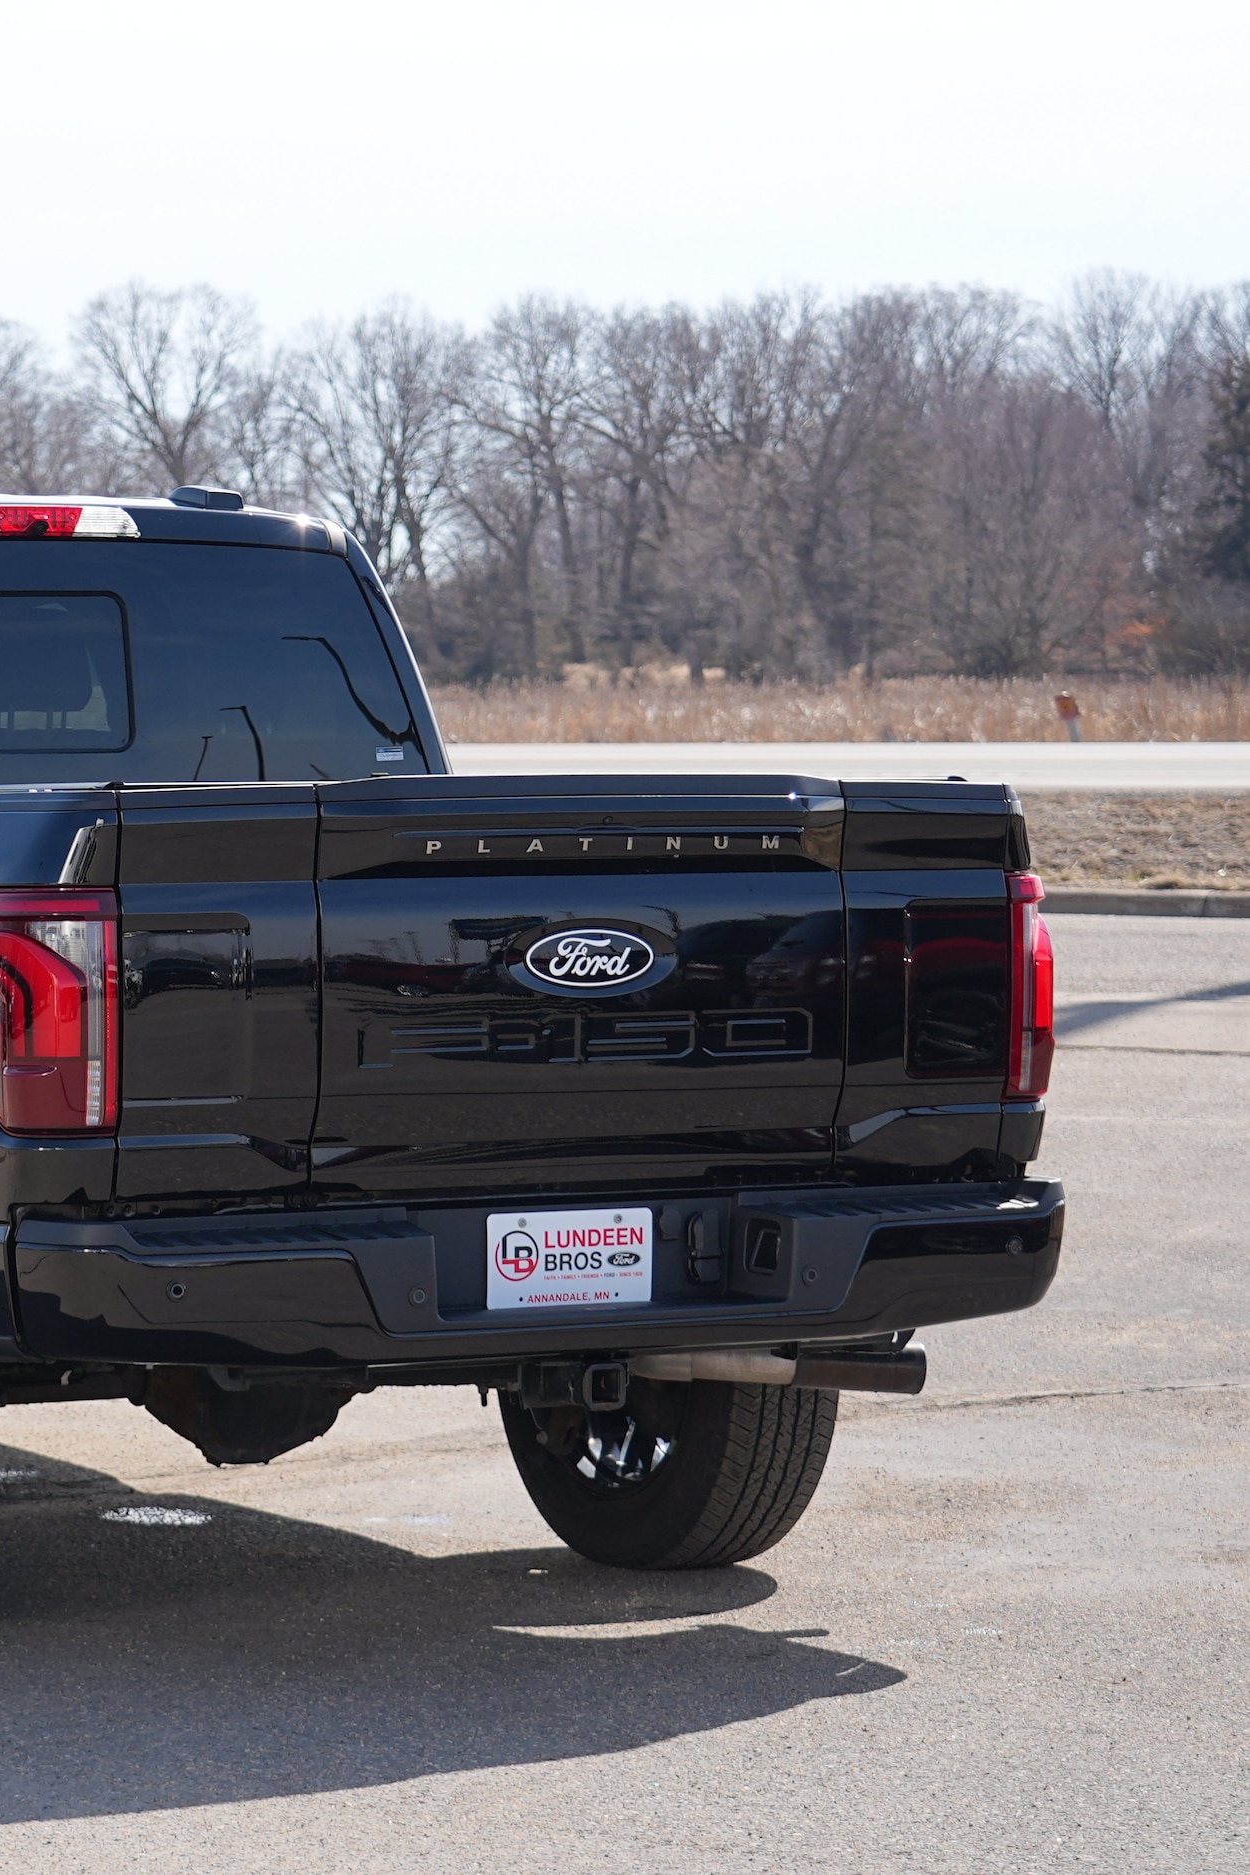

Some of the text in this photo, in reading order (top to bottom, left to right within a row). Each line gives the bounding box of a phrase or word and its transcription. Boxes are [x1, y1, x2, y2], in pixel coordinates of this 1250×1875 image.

[425, 834, 781, 856] PLATINUM
[548, 936, 631, 978] Ford
[543, 1227, 644, 1249] LUNDEEN
[544, 1251, 602, 1272] BROS
[610, 1252, 638, 1266] Ford
[527, 1291, 610, 1304] ANNANDALE, MN
